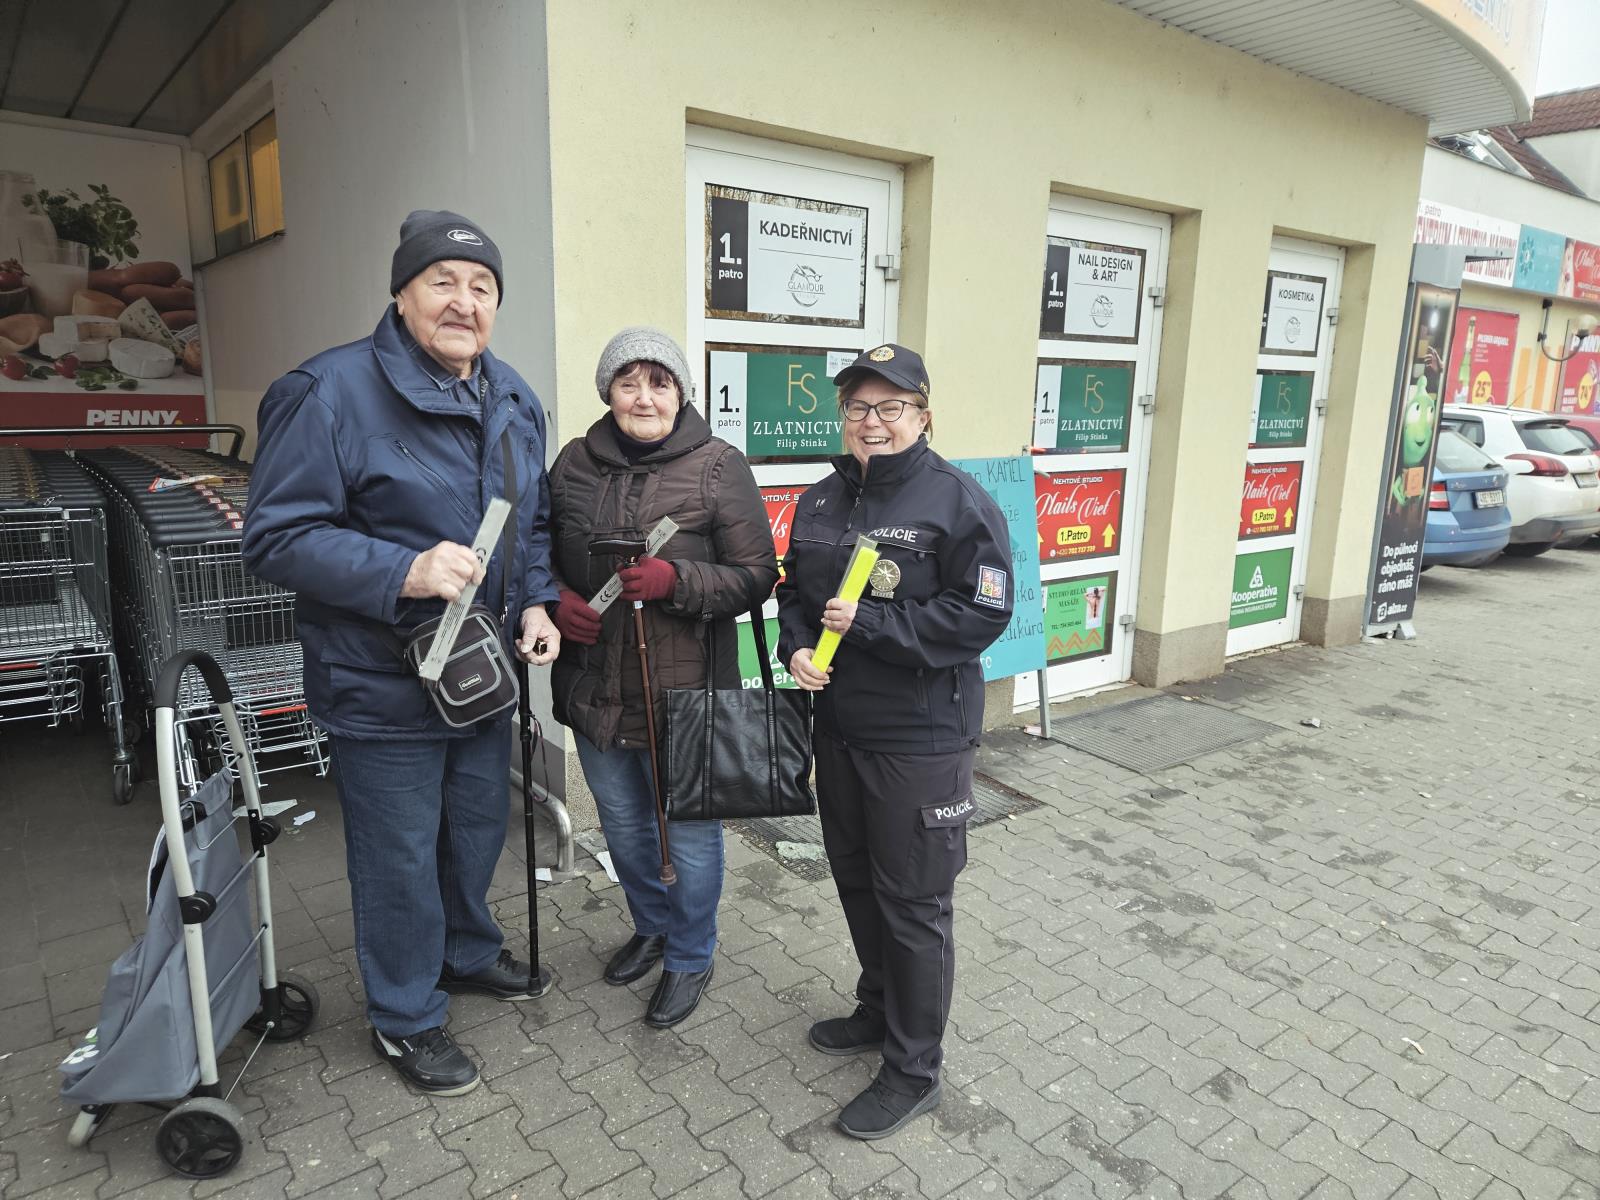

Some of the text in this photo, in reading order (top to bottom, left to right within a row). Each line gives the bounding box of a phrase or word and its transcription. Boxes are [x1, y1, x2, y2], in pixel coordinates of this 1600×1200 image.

[760, 220, 852, 246] KADEŘNICTVÍ
[719, 232, 742, 264] 1.
[1078, 253, 1133, 271] NAIL DESIGN
[718, 269, 743, 280] patro
[1092, 268, 1118, 282] & ART
[1049, 272, 1063, 296] 1.
[1278, 289, 1315, 302] KOSMETIKA
[1048, 299, 1064, 308] patro
[719, 384, 740, 413] 1.
[1041, 391, 1055, 413] 1.
[718, 417, 741, 428] patro
[753, 420, 843, 435] ZLATNICTV
[1039, 416, 1055, 425] patro
[1061, 416, 1124, 431] ZLATNICTVÍ
[1260, 417, 1304, 429] ZLATNICTVÍ
[776, 438, 827, 449] Filip Stinka
[986, 458, 1026, 482] KAMEL
[762, 491, 791, 503] HTOVÉ
[868, 528, 918, 543] POLICIE
[977, 595, 1003, 606] POLICIE
[1232, 585, 1277, 603] Kooperativa
[935, 799, 974, 819] POLICIE
